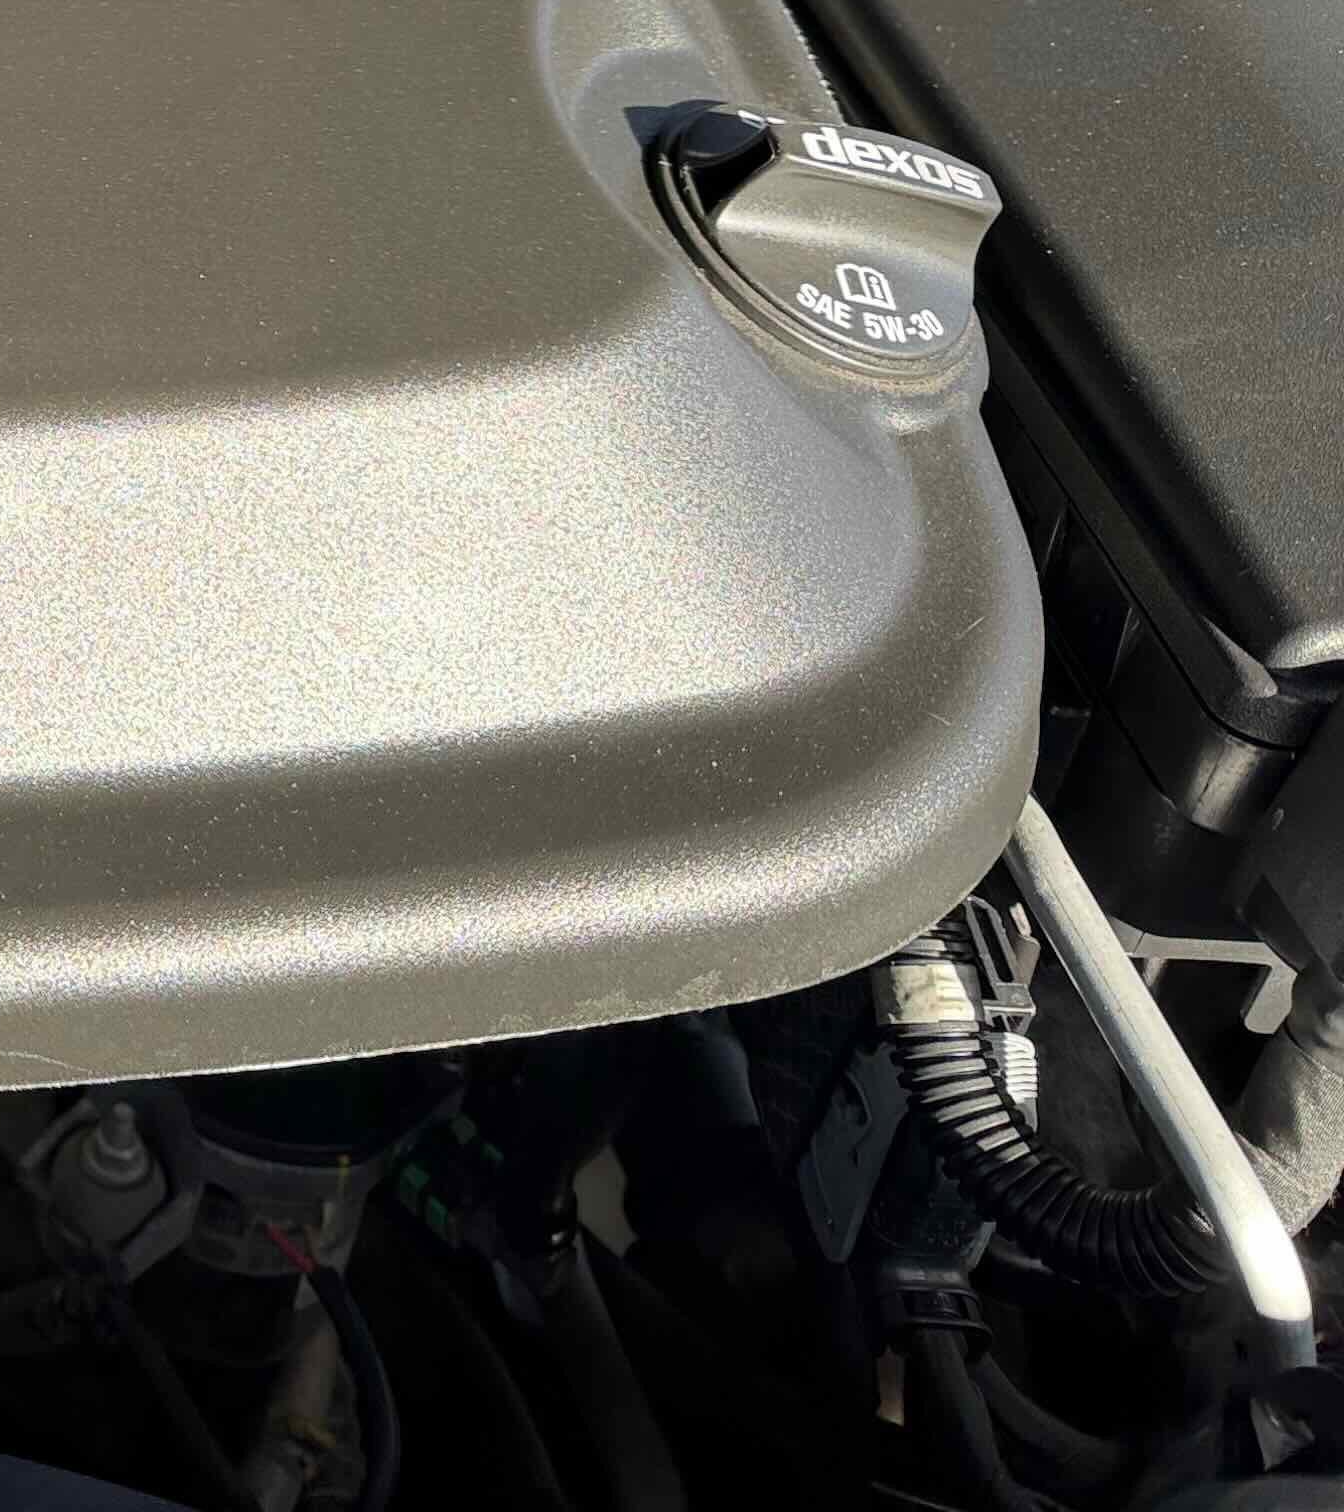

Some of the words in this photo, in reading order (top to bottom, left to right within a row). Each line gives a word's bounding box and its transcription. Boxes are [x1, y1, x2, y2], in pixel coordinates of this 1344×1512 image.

[800, 126, 985, 200] dexos
[796, 282, 854, 330] SAE
[862, 308, 945, 344] 5W-30
